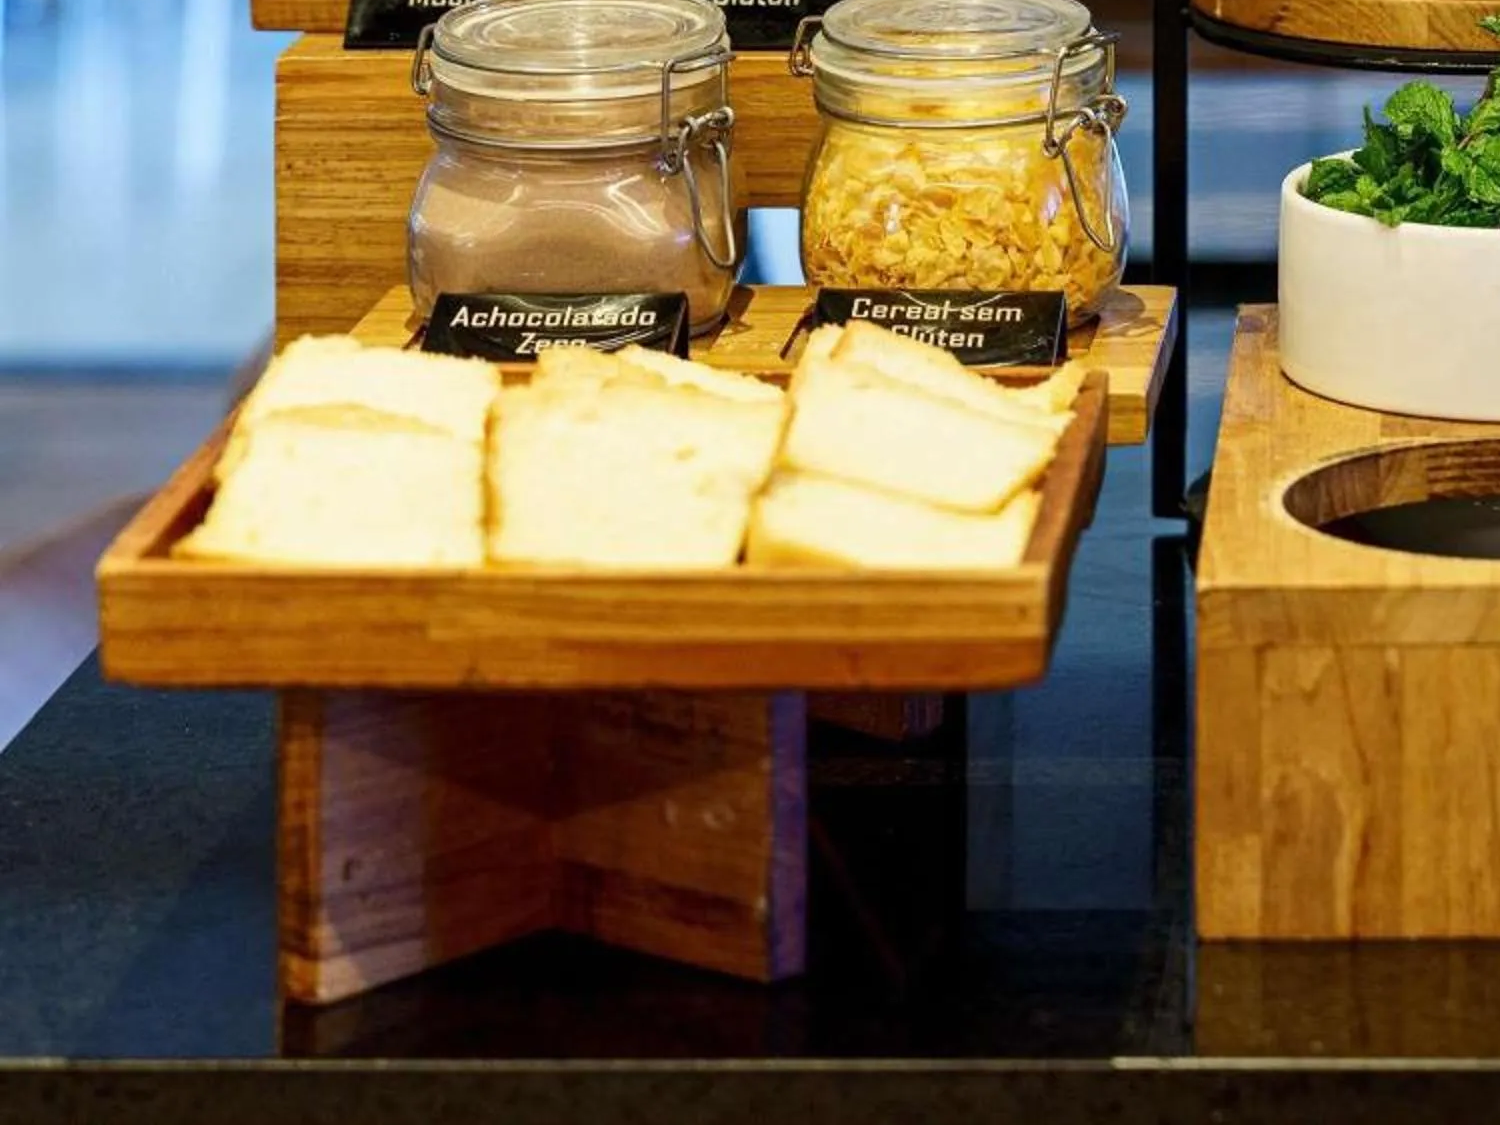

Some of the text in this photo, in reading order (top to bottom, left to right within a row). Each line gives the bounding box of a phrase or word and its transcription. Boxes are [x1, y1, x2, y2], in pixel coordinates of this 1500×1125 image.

[451, 305, 657, 328] Achocolatado
[851, 297, 1023, 322] Cereal sem
